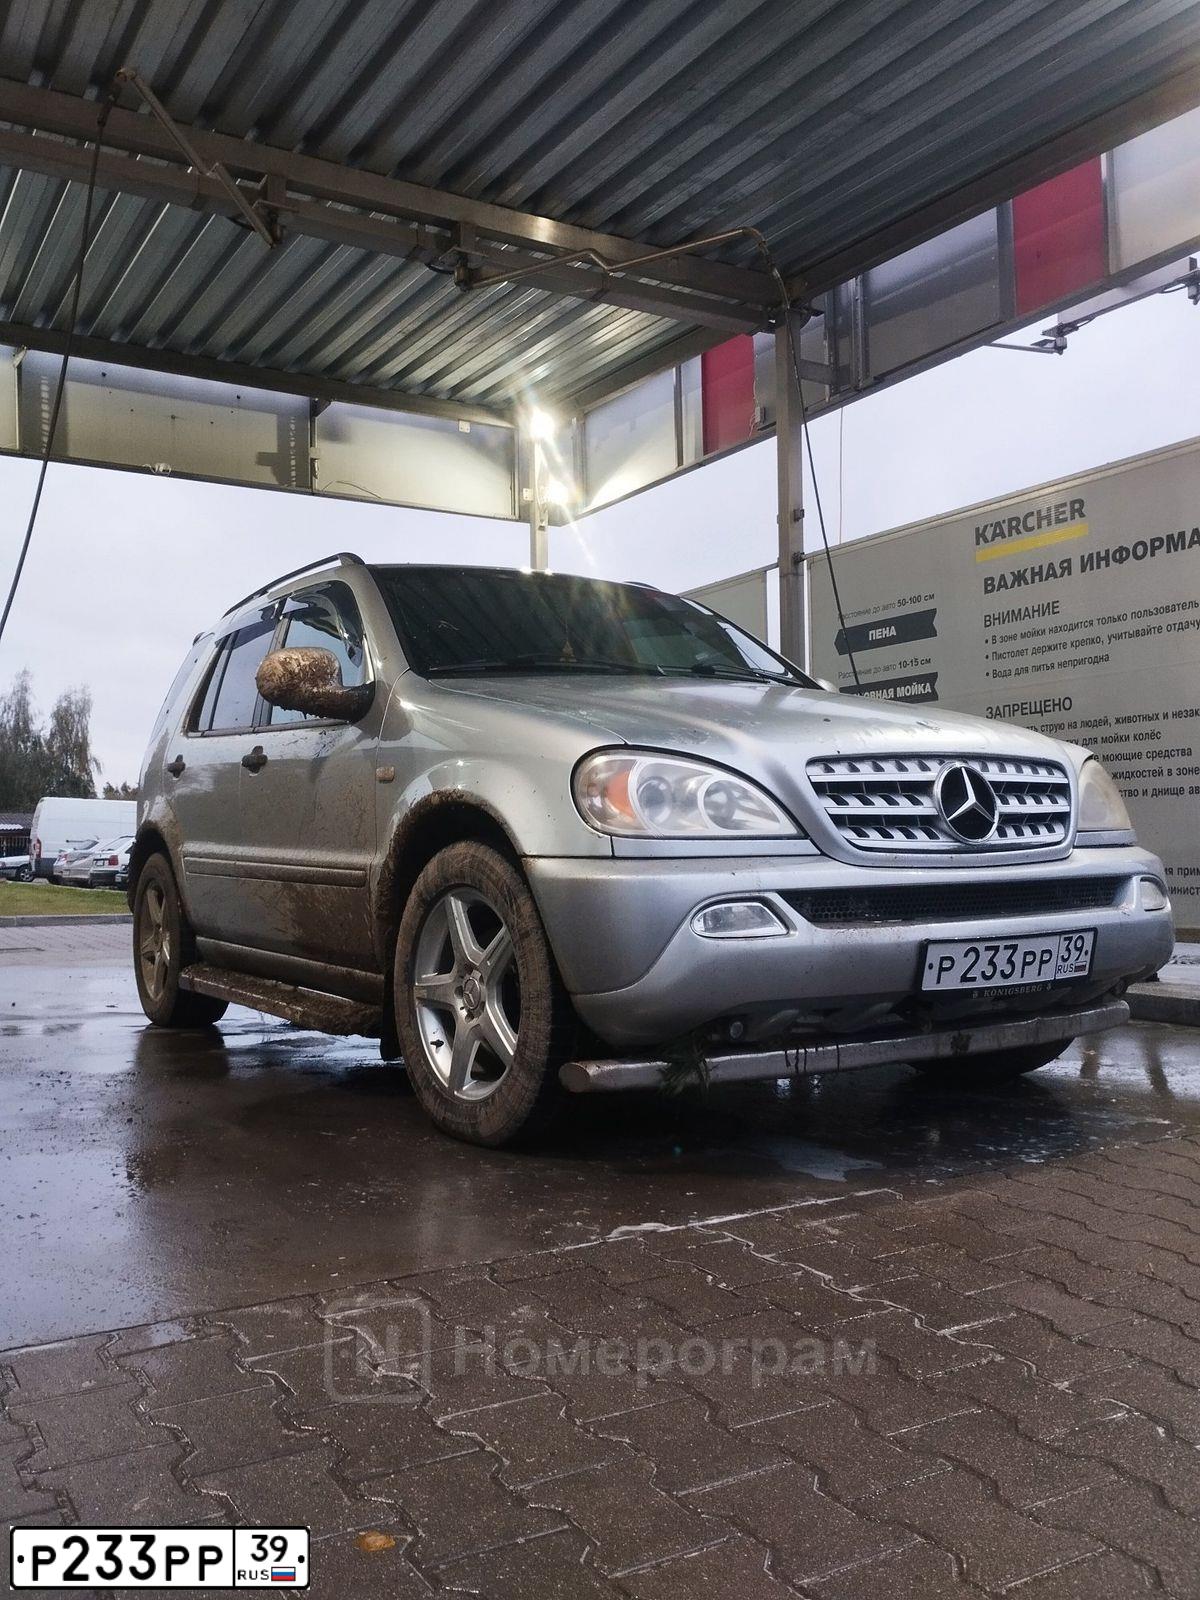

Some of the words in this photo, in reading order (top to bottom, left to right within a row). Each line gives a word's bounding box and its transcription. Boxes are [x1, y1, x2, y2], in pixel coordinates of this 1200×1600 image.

[974, 497, 1086, 546] KÄRCHER
[983, 557, 1072, 595] ВАЖНАЯ
[1080, 527, 1200, 573] ИНФОРМА
[897, 594, 922, 607] 50-100
[923, 593, 935, 602] см
[983, 600, 1060, 628] ВНИМАНИЕ
[991, 635, 997, 644] В
[999, 632, 1018, 643] зоне
[1020, 627, 1046, 640] мойки
[1048, 618, 1094, 635] находится
[1097, 612, 1128, 626] только
[1130, 600, 1200, 620] пользователь
[868, 625, 897, 641] ПЕНА
[991, 648, 1029, 661] Пистолет
[1031, 640, 1067, 656] держите
[1070, 634, 1104, 650] крепко,
[1107, 625, 1163, 645] учитывайте
[1166, 618, 1200, 633] отдачу
[898, 657, 919, 669] 10-15
[920, 657, 931, 666] см
[992, 668, 1012, 678] Вода
[1014, 665, 1029, 676] для
[1031, 661, 1055, 673] питья
[1057, 652, 1110, 669] непригодна
[896, 682, 932, 698] МОЙКА
[985, 696, 1073, 719] ЗАПРЕЩЕНО
[1040, 721, 1065, 734] струю
[1068, 720, 1078, 730] на
[1080, 715, 1112, 729] людей,
[1114, 711, 1160, 725] животных
[1163, 711, 1169, 720] и
[1172, 707, 1200, 719] незак
[1081, 736, 1098, 748] для
[1101, 731, 1130, 745] мойки
[1133, 728, 1162, 742] колёс
[1102, 751, 1143, 763] моющие
[1146, 747, 1192, 761] средства
[1111, 767, 1164, 780] жидкостей
[1167, 768, 1173, 777] в
[1176, 766, 1200, 776] зоне
[1142, 788, 1148, 797] и
[1151, 786, 1185, 798] днище
[1168, 886, 1200, 896] инист
[935, 943, 1053, 985] Р233РР
[1060, 934, 1085, 963] 39
[1056, 963, 1074, 974] RUS
